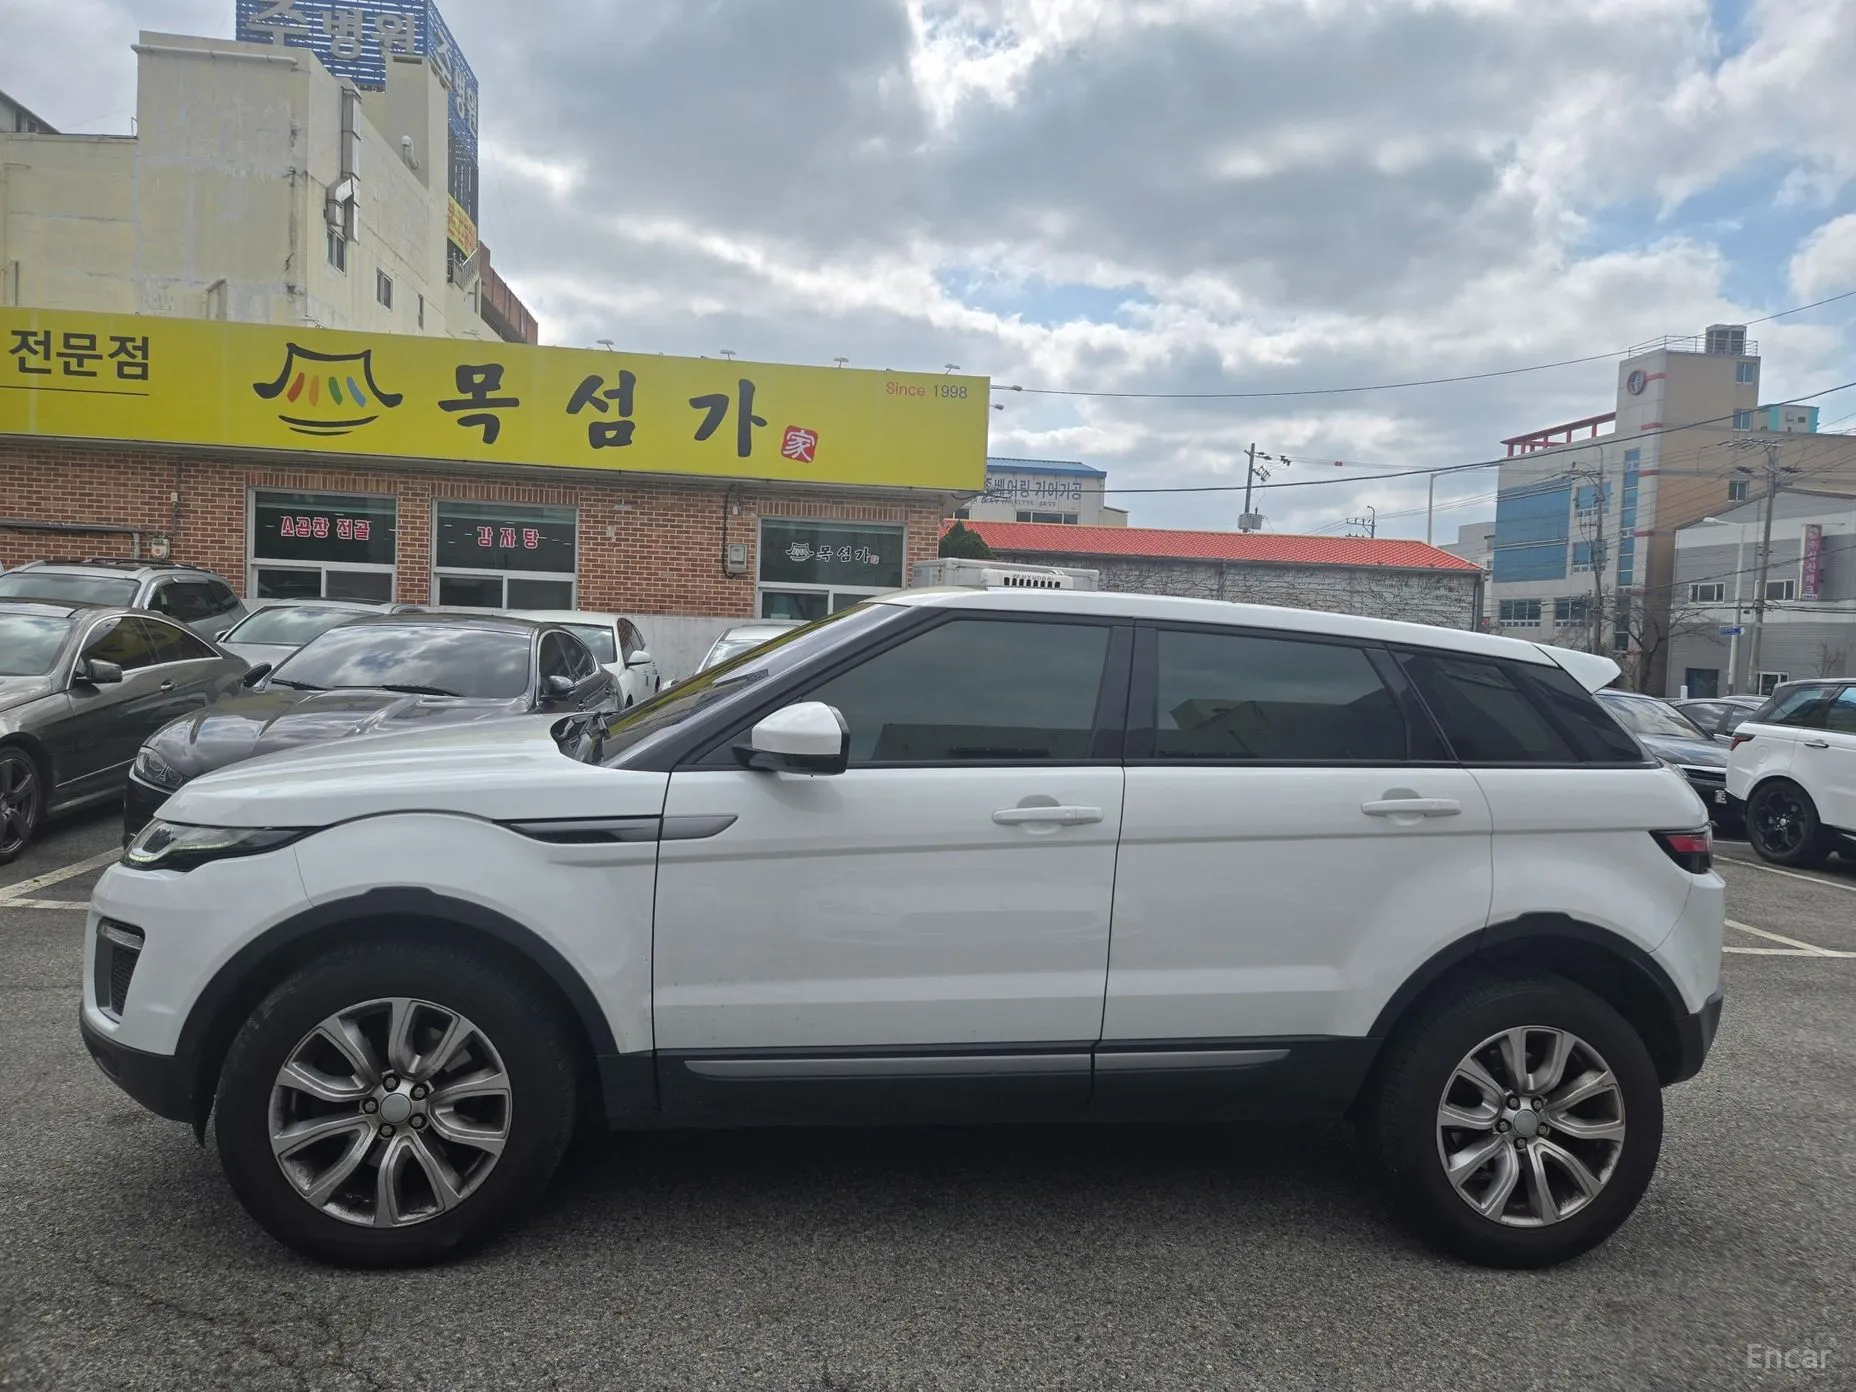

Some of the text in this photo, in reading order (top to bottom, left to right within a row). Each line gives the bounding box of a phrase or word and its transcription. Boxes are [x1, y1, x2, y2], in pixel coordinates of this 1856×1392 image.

[9, 330, 149, 380] 전문점
[886, 381, 968, 399] Since 1998
[438, 363, 767, 458] 목섬가
[280, 516, 370, 540] 소곱창 전골
[477, 526, 540, 549] 감자탕
[817, 545, 871, 564] 목섬가
